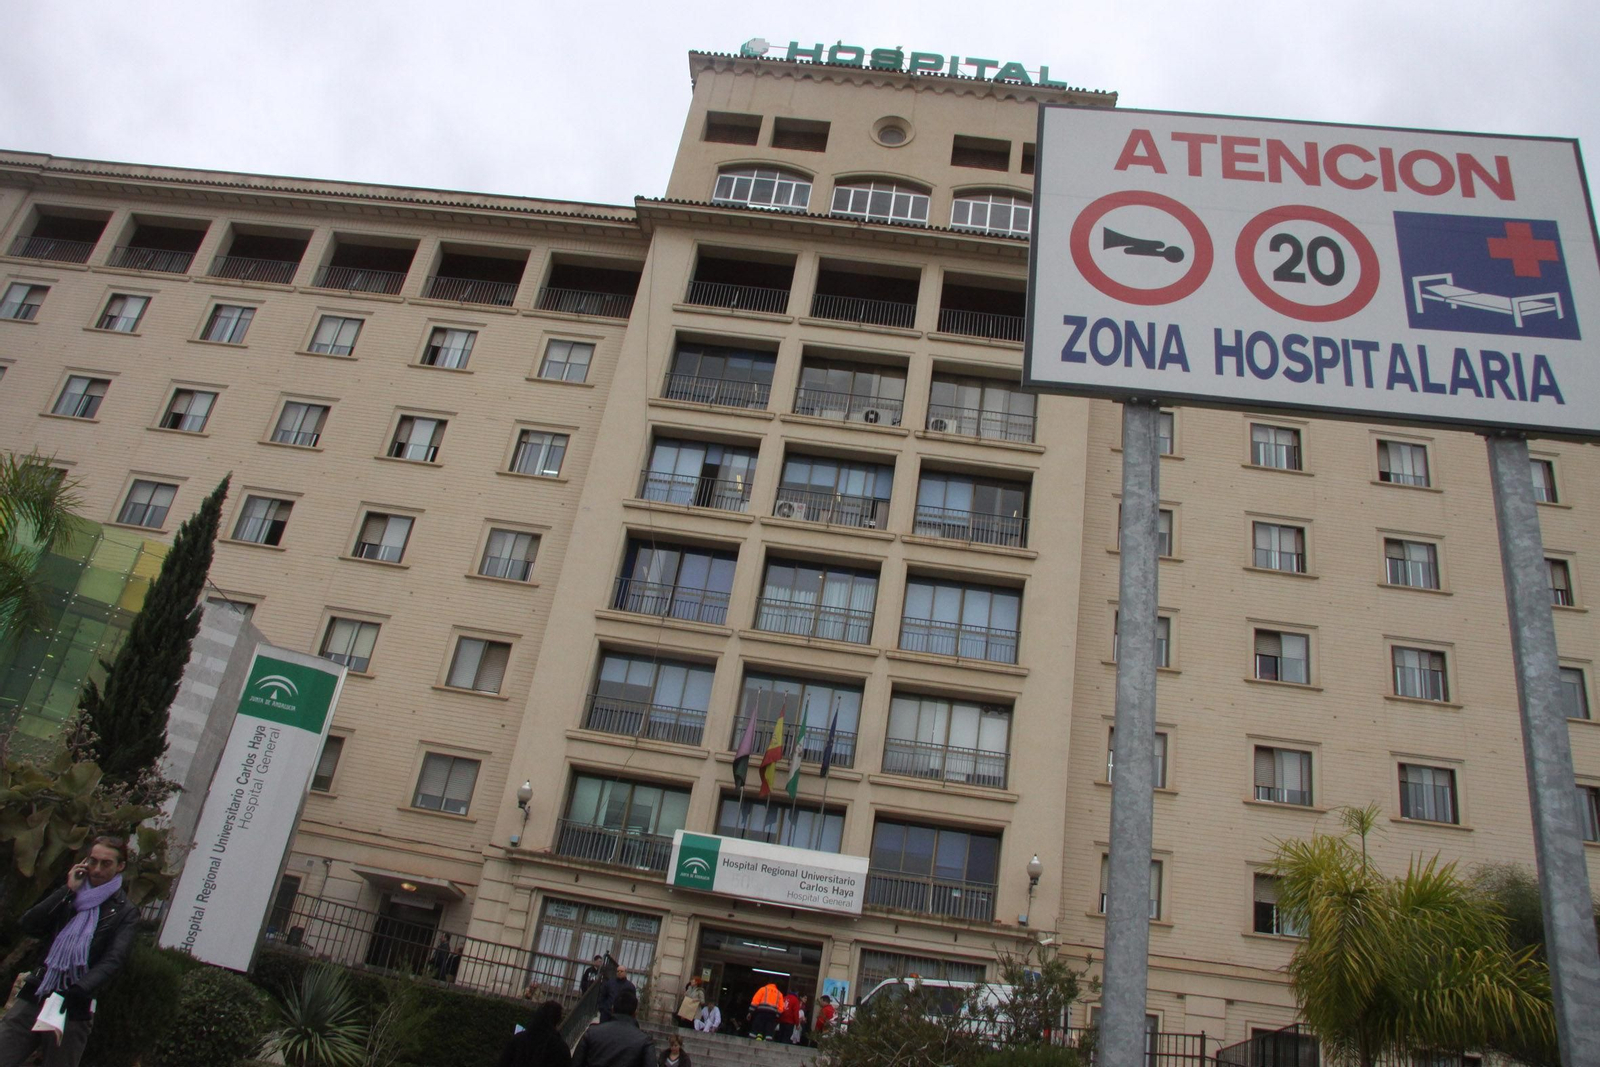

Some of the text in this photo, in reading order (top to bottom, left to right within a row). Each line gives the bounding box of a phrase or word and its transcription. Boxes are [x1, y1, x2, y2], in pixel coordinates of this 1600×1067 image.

[787, 41, 1067, 88] HOSPITAL
[1114, 128, 1516, 201] ATENCION
[1269, 232, 1345, 287] 20
[1061, 314, 1565, 404] ZONA HOSPITALARIA
[237, 727, 281, 830] Hospital General
[180, 724, 267, 953] Hospital Regional Universitario Carlos Haya
[722, 858, 856, 886] Hospital Regional Universitario
[787, 890, 853, 908] Hospital General
[799, 881, 854, 898] Carlos Haya
